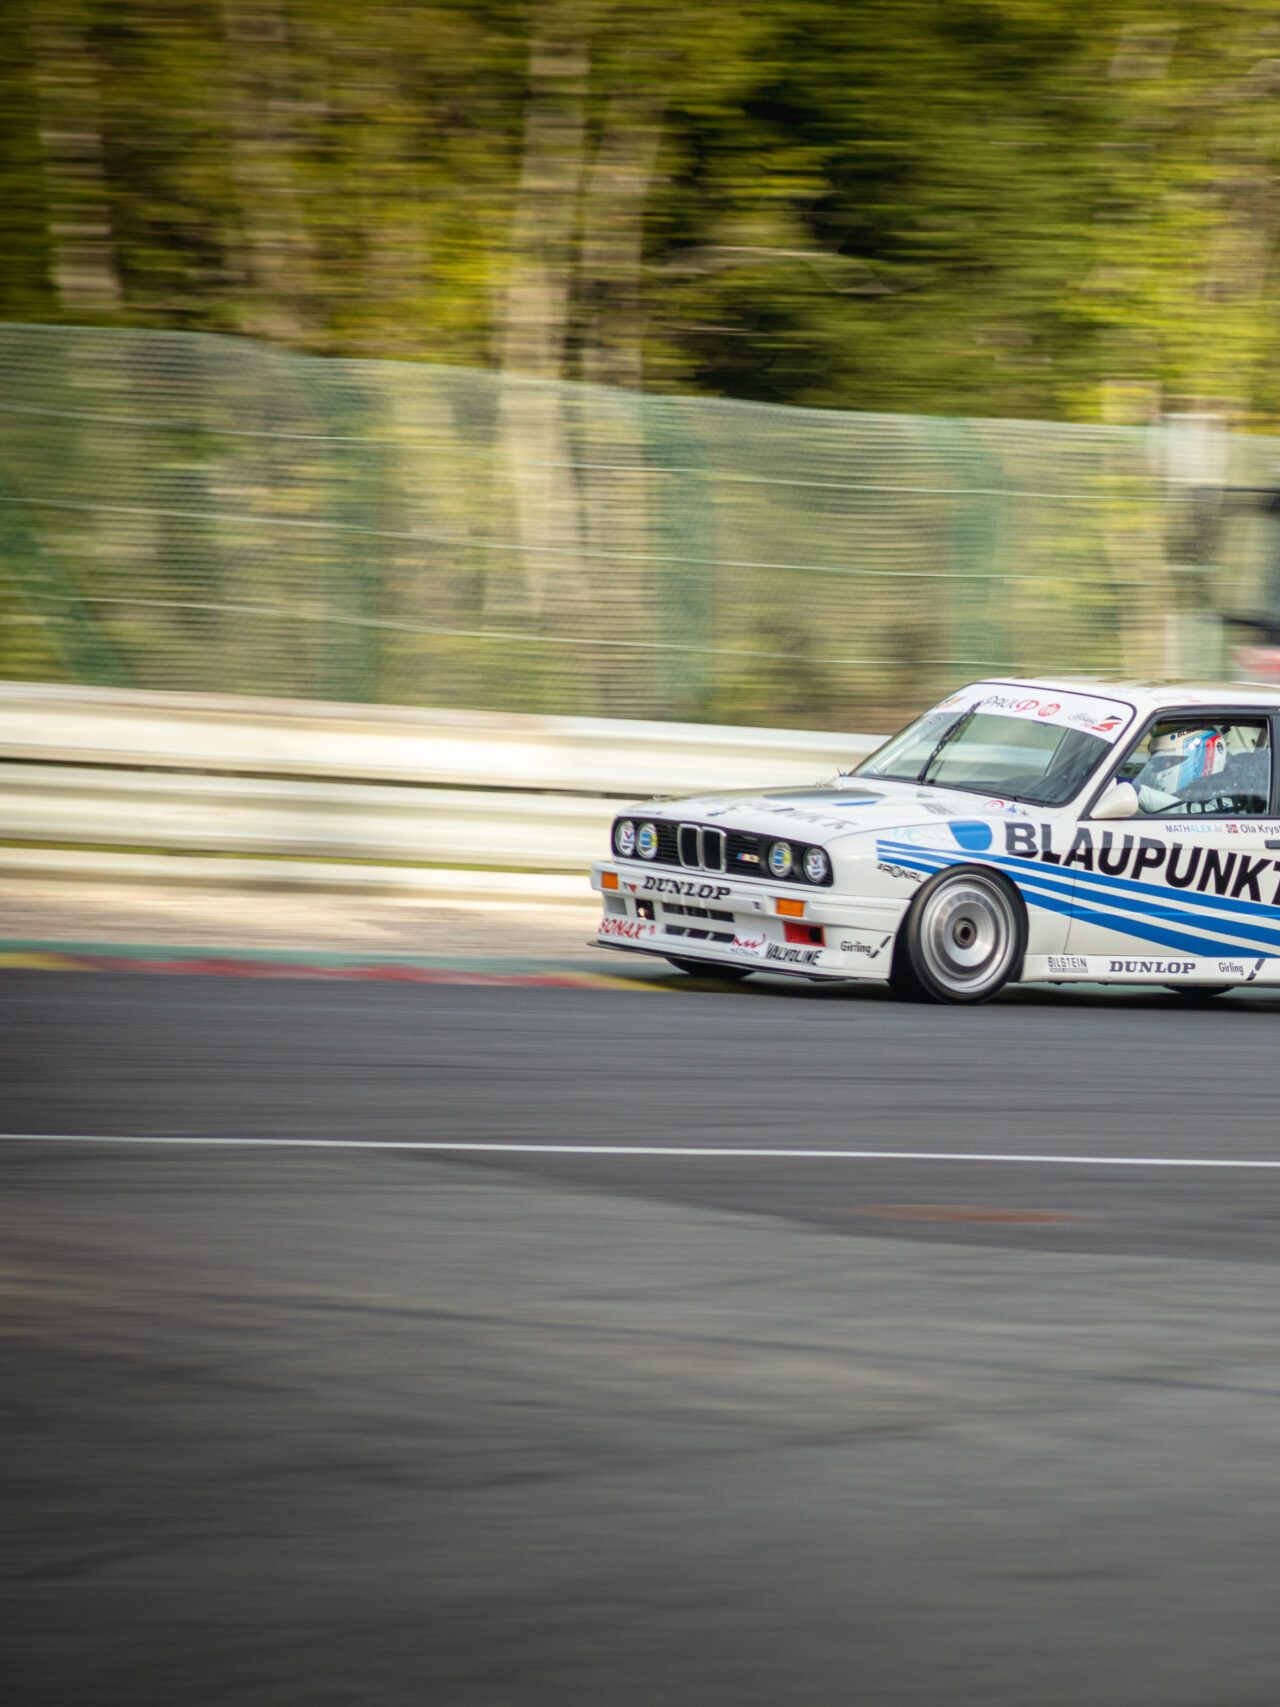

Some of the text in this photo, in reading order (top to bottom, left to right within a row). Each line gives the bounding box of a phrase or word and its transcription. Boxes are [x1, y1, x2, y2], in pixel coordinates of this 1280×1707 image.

[1240, 824, 1257, 834] Ola
[642, 876, 731, 900] DUNLOP
[765, 942, 823, 966] VALVOLINE
[840, 940, 872, 958] Girling
[1047, 956, 1088, 968] BILSTEIN
[1108, 960, 1197, 975] DUNLOP
[1218, 961, 1245, 976] Girling
